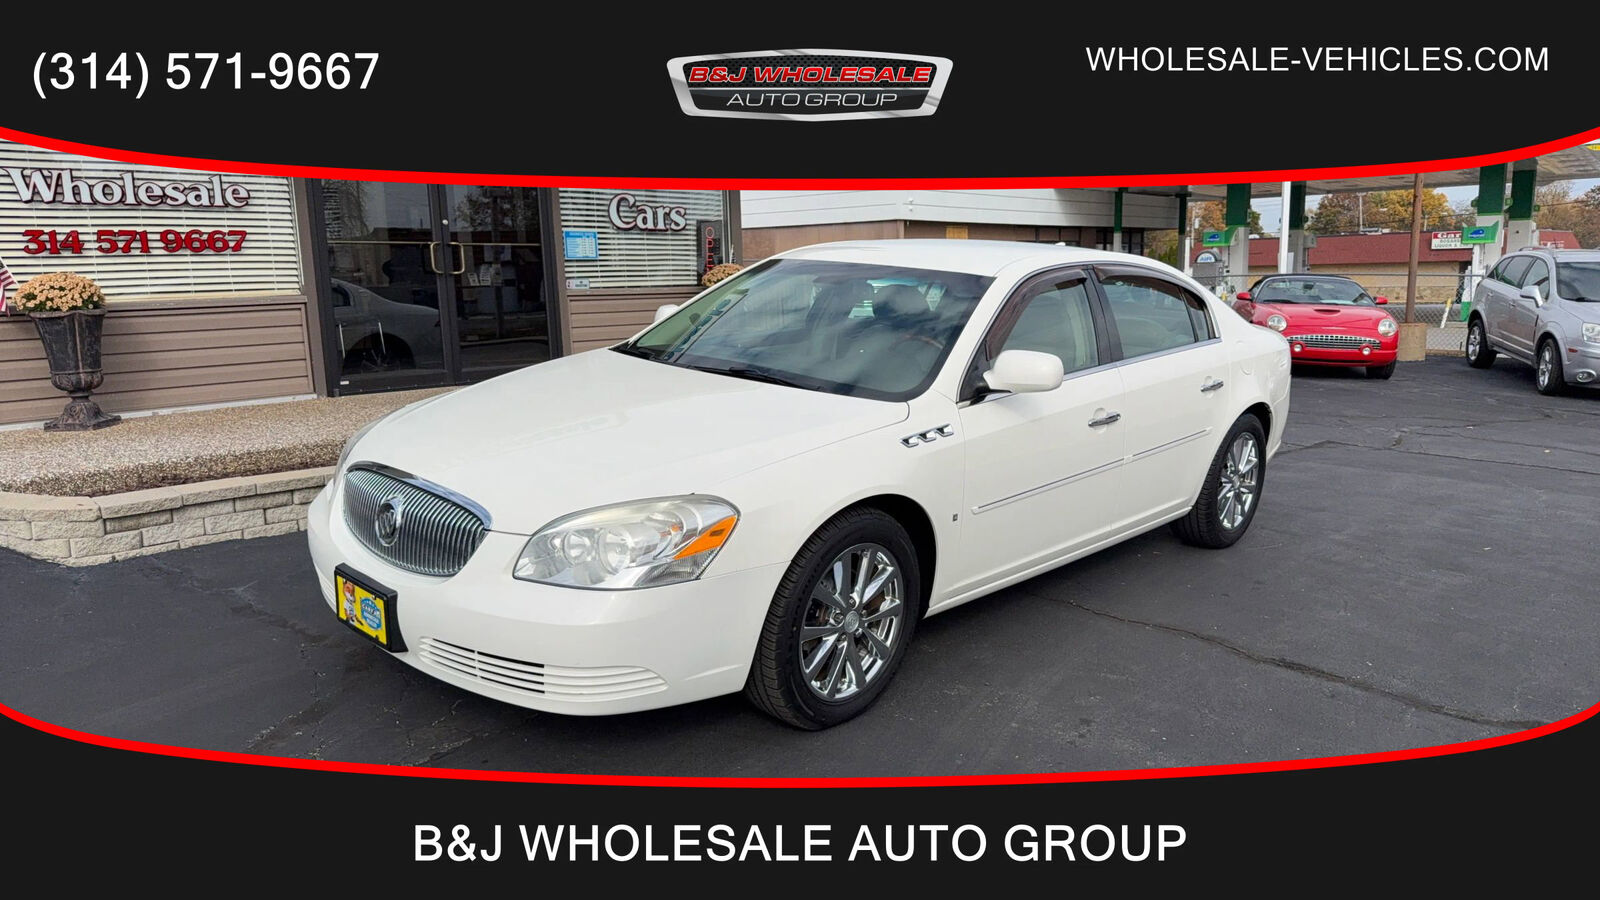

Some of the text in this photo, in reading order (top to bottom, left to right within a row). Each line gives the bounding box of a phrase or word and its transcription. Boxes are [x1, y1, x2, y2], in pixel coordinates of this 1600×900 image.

[3, 167, 251, 208] Wholesale
[608, 192, 687, 232] Cars
[22, 229, 248, 255] 314 571 9667
